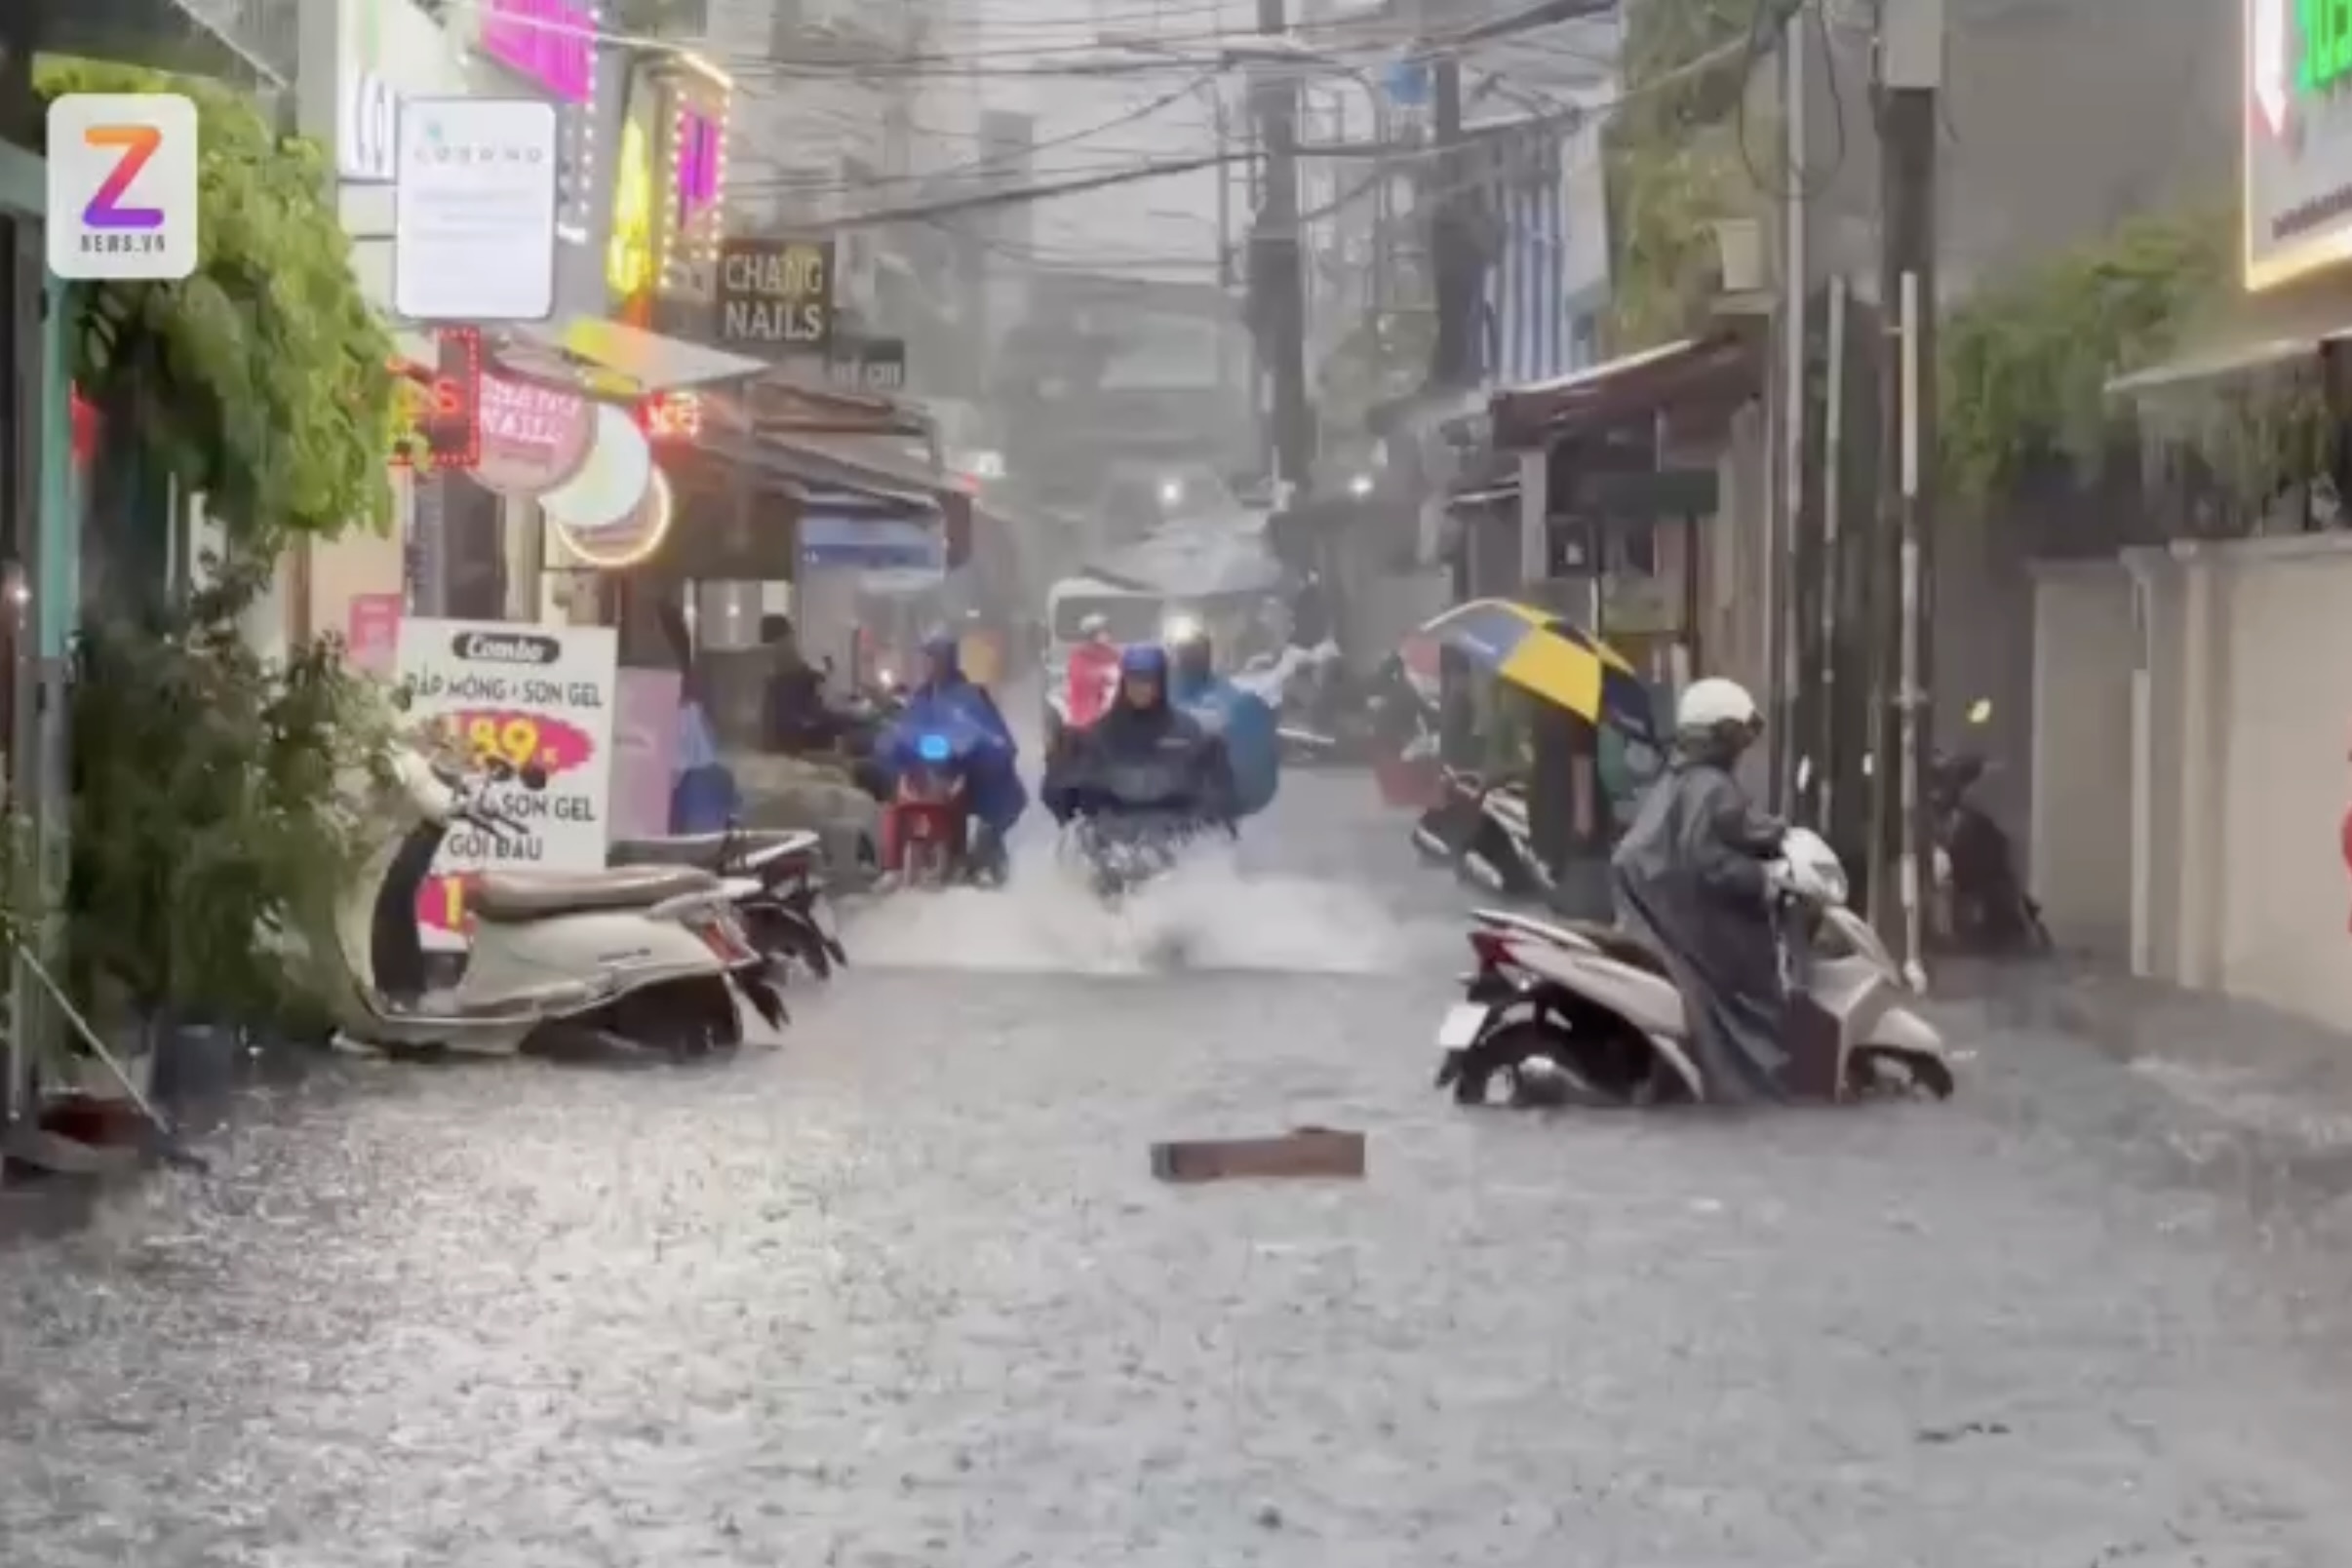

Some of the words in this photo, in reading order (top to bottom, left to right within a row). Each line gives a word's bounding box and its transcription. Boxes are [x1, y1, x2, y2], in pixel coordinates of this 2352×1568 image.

[725, 254, 823, 293] CHANG
[725, 300, 822, 341] NAILS
[467, 634, 543, 661] Combo
[568, 683, 603, 708] GEL
[555, 796, 597, 821] GEL
